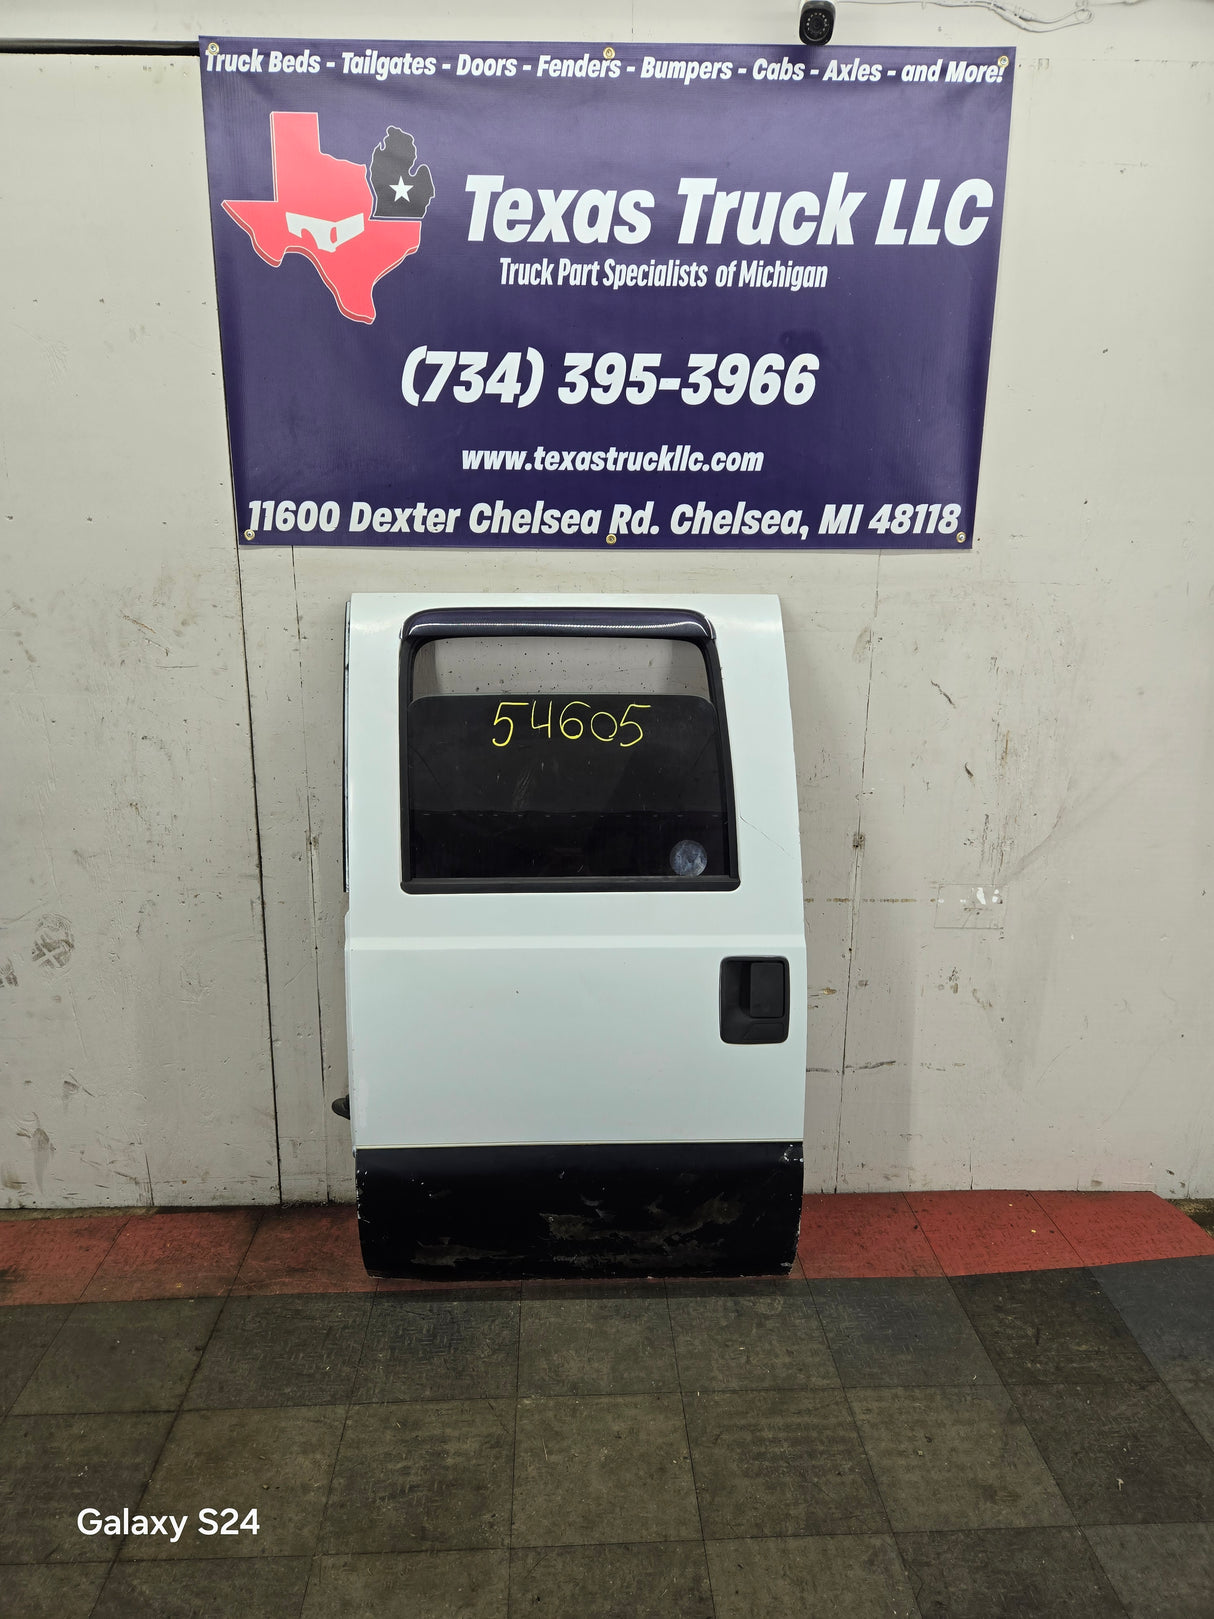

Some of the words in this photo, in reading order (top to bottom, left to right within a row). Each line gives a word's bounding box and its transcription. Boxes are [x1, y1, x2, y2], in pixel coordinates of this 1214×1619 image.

[205, 48, 264, 72] Truck
[268, 48, 322, 74] Beds
[341, 48, 437, 81] Tailgates
[455, 53, 518, 77] Doors
[536, 54, 622, 78] Fenders
[639, 55, 734, 86] Bumpers
[752, 56, 806, 81] Cabs
[821, 57, 883, 82] Axles
[901, 59, 943, 82] and
[944, 60, 1006, 83] More!
[464, 174, 656, 245] Texas
[677, 171, 868, 246] Truck
[874, 178, 994, 247] LLC
[499, 257, 555, 286] Truck
[557, 257, 601, 286] Part
[602, 258, 709, 290] Specialists
[715, 260, 738, 288] of
[738, 260, 828, 292] Michigan
[401, 345, 544, 409] (734)
[557, 352, 820, 406] 395-3966
[462, 444, 765, 472] www.texastruckllc.com
[248, 500, 340, 532] 11600
[348, 501, 462, 533] Dexter
[469, 500, 602, 535] Chelsea
[609, 502, 659, 535] Rd.
[670, 501, 809, 540] Chelsea,
[818, 504, 865, 535] MI
[868, 504, 961, 534] 48118
[491, 700, 652, 748] 54605
